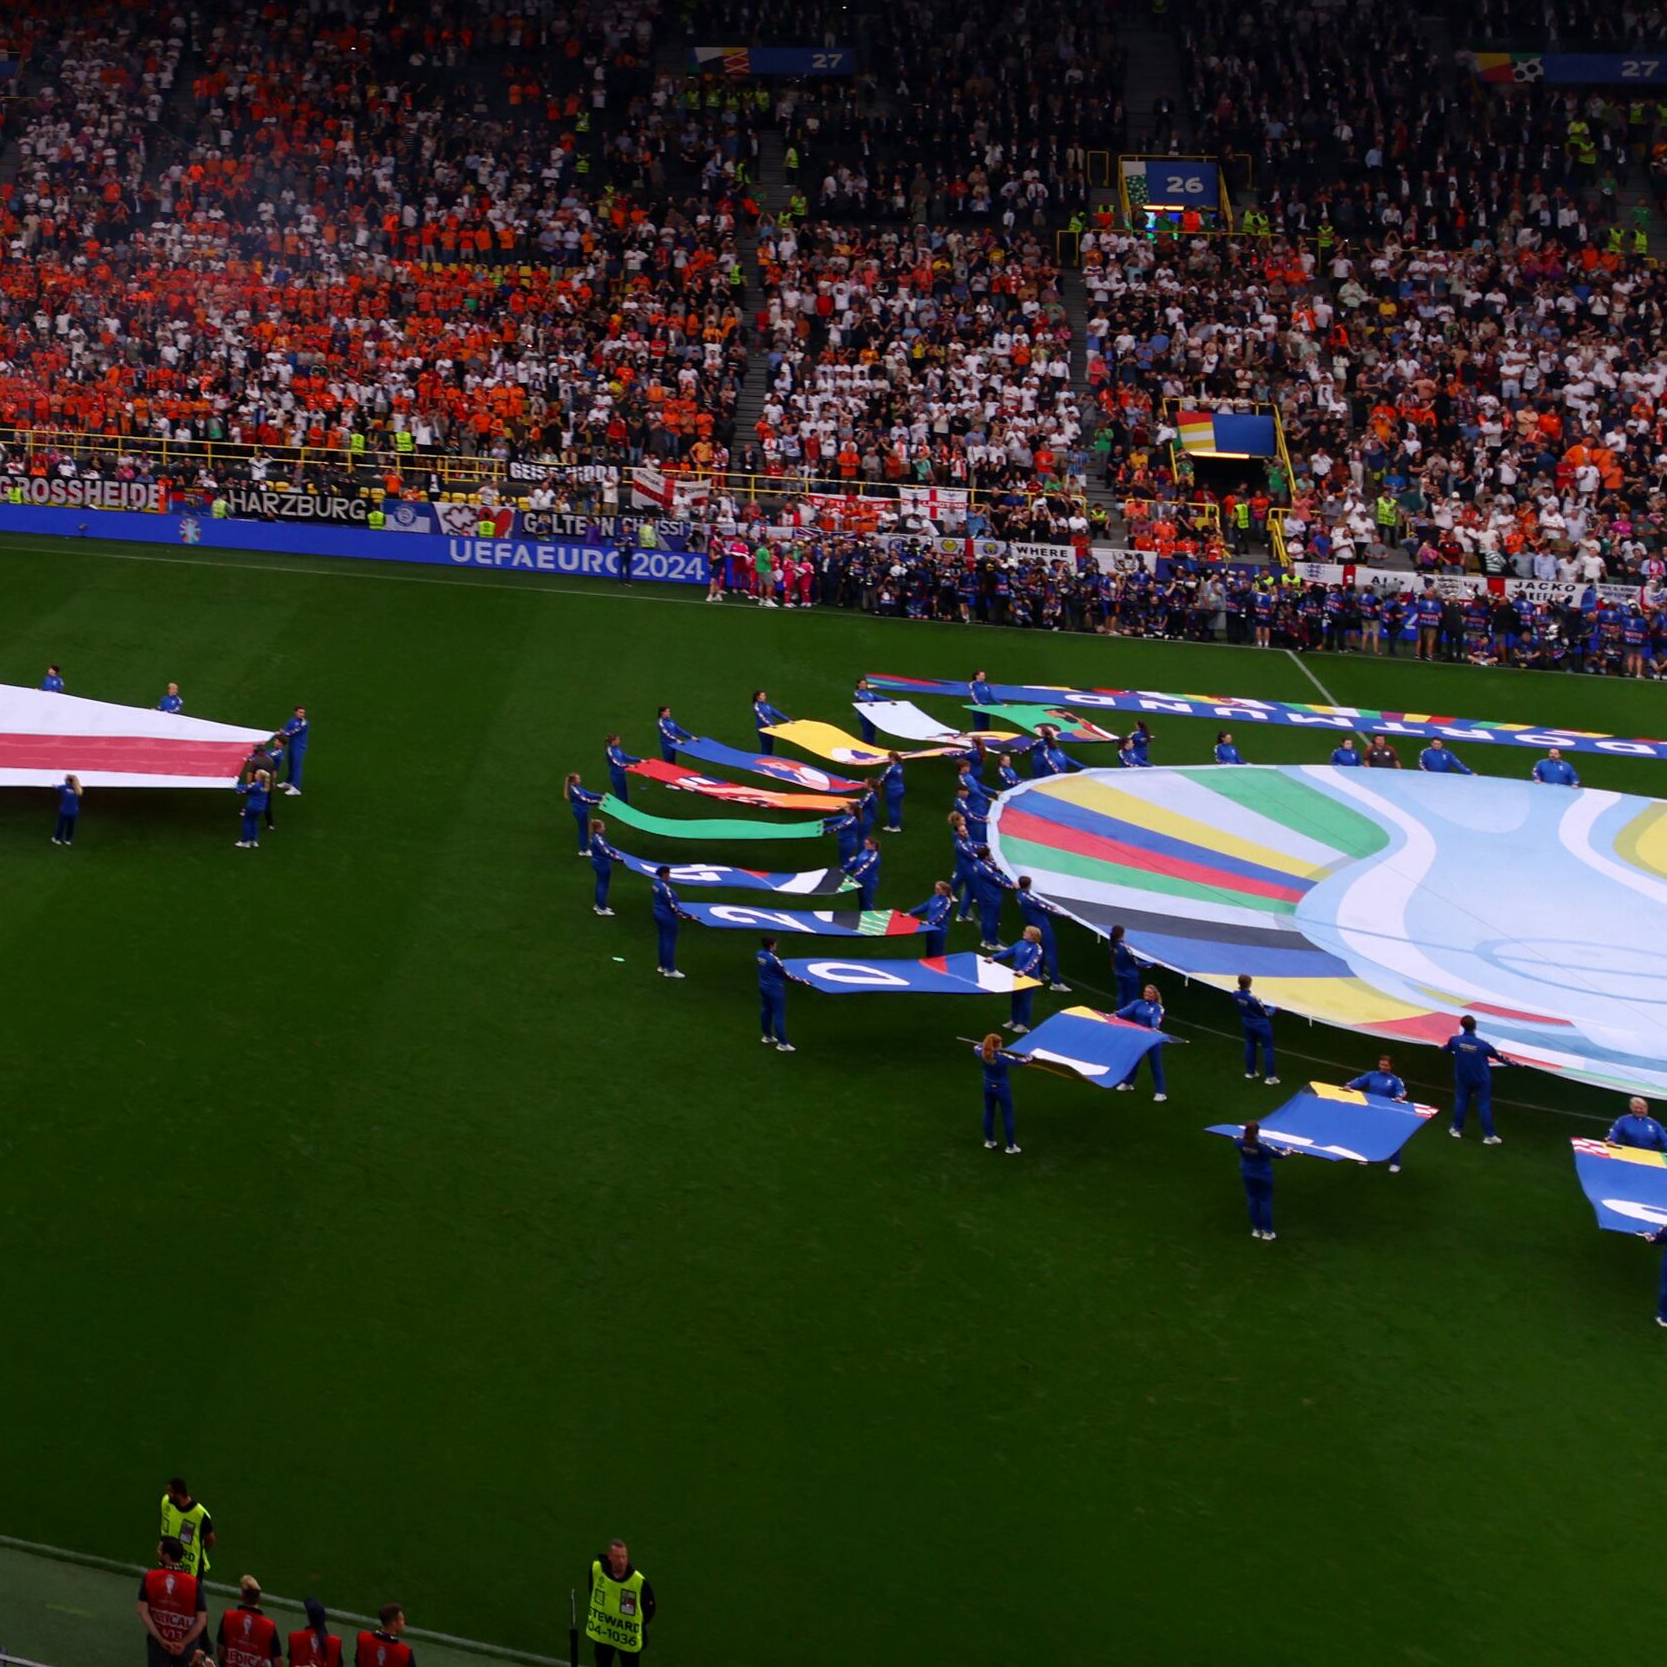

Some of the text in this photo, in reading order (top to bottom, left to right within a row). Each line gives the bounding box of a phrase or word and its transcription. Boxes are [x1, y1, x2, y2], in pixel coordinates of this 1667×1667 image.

[811, 53, 843, 69] 27
[1621, 60, 1660, 77] 27
[1166, 176, 1204, 193] 26
[228, 489, 368, 521] HARZBURG
[523, 511, 616, 537] GOLTEN
[1018, 546, 1068, 558] WHERE
[1514, 581, 1576, 592] JACKO
[588, 1607, 640, 1634] STEWARD
[588, 1622, 638, 1647] 04-1036
